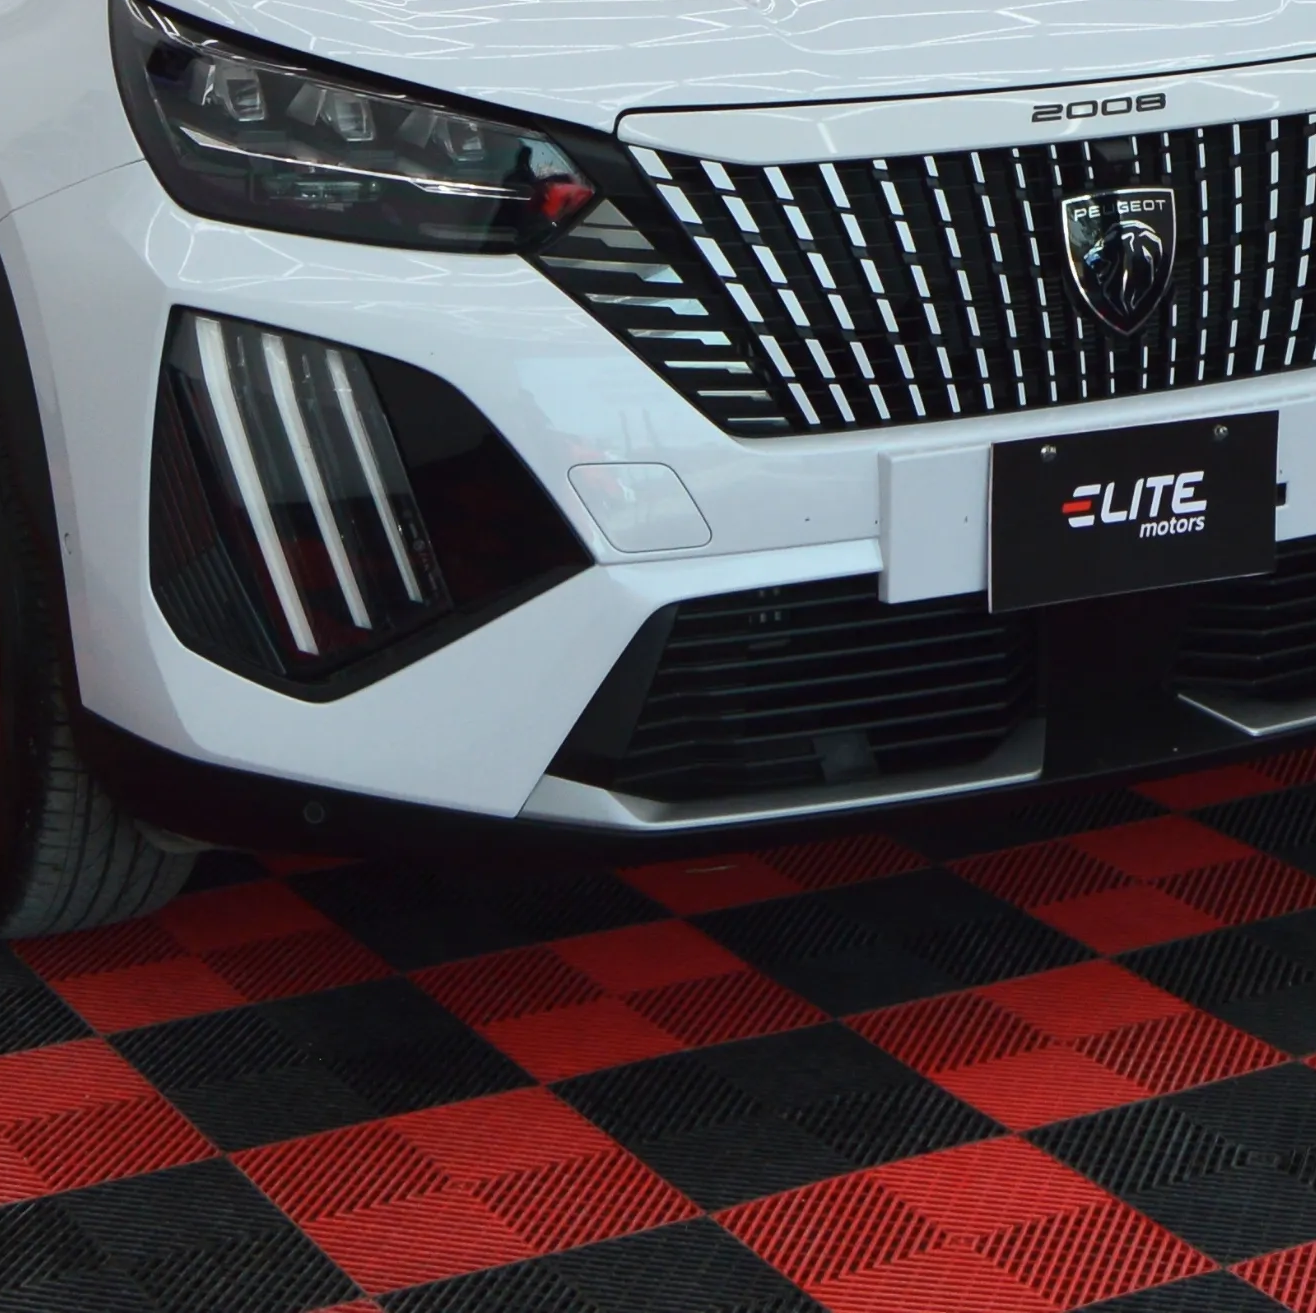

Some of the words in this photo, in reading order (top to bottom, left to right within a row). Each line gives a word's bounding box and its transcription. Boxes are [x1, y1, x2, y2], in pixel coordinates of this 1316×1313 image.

[1031, 92, 1167, 123] 2008
[1061, 470, 1208, 528] ELITE
[1139, 516, 1206, 538] motors
